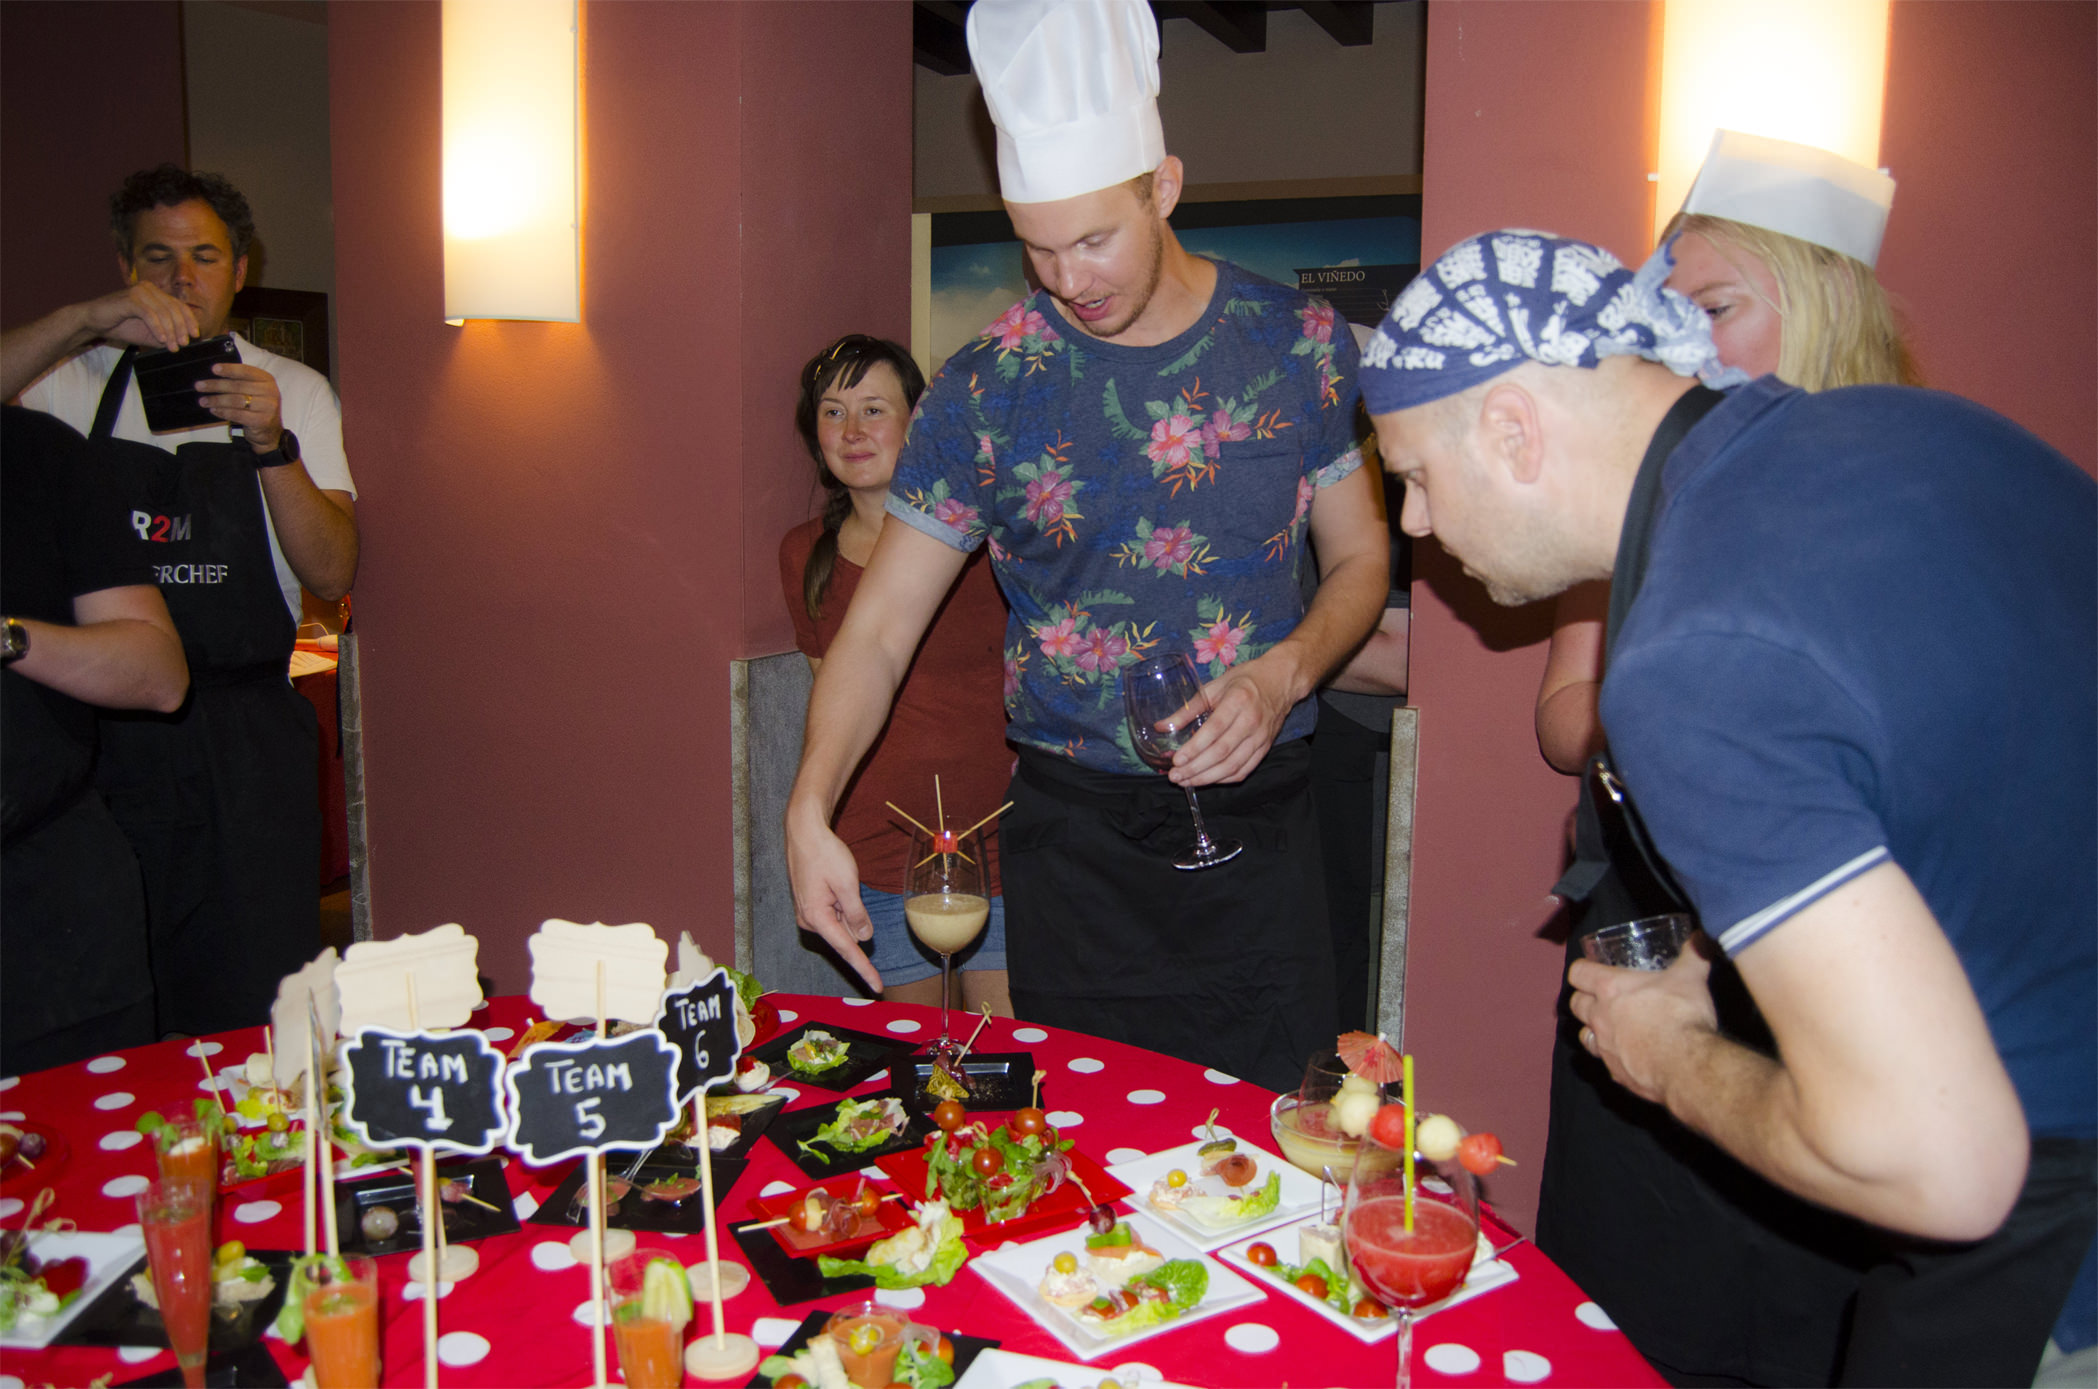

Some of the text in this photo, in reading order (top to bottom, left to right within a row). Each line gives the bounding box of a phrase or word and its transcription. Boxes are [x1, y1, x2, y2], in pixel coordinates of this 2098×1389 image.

[1301, 270, 1366, 284] EL VIÑEDO
[131, 510, 192, 542] R2M
[674, 994, 721, 1030] TEAM
[380, 1039, 469, 1084] TEAM
[694, 1030, 709, 1069] 6
[543, 1058, 633, 1095] TEAM
[409, 1085, 453, 1130] 4
[573, 1098, 607, 1140] 5
